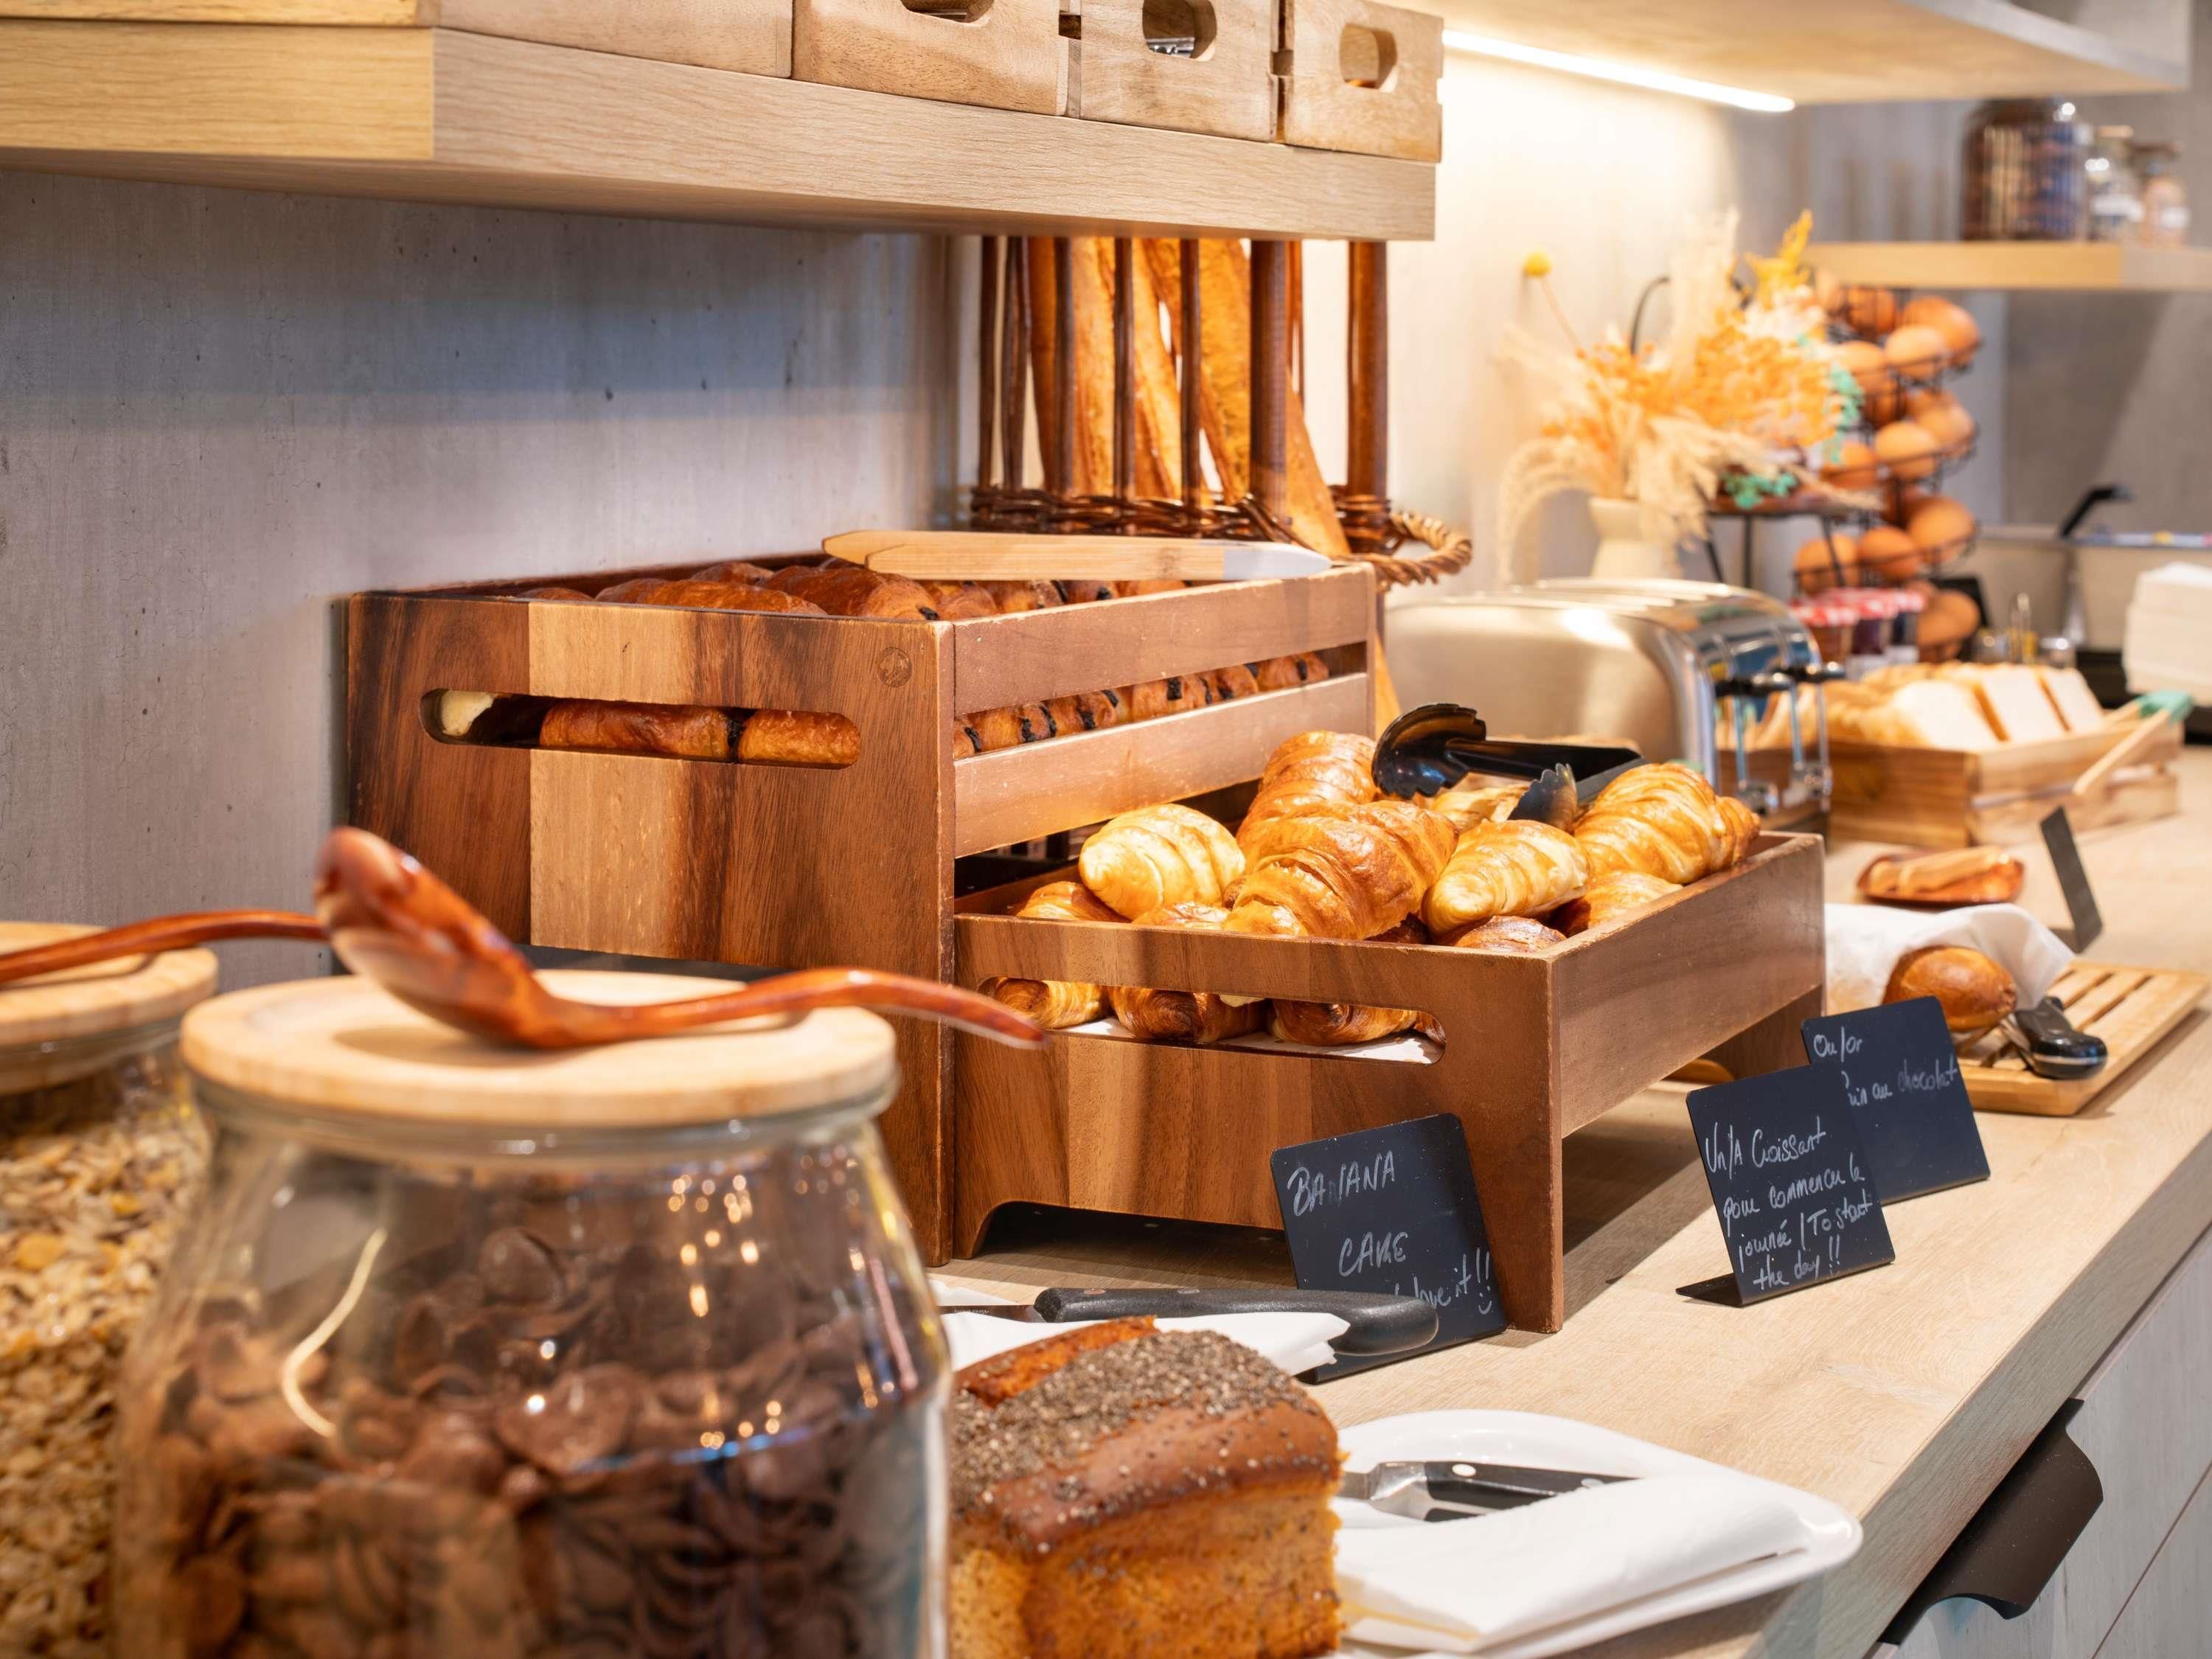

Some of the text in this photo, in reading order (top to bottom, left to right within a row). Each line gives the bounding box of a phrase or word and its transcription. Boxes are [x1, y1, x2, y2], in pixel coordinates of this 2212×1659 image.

[1841, 1053, 1958, 1106] in au chocolat
[1338, 1231, 1408, 1277] CAKE
[1753, 1253, 1790, 1290] the
